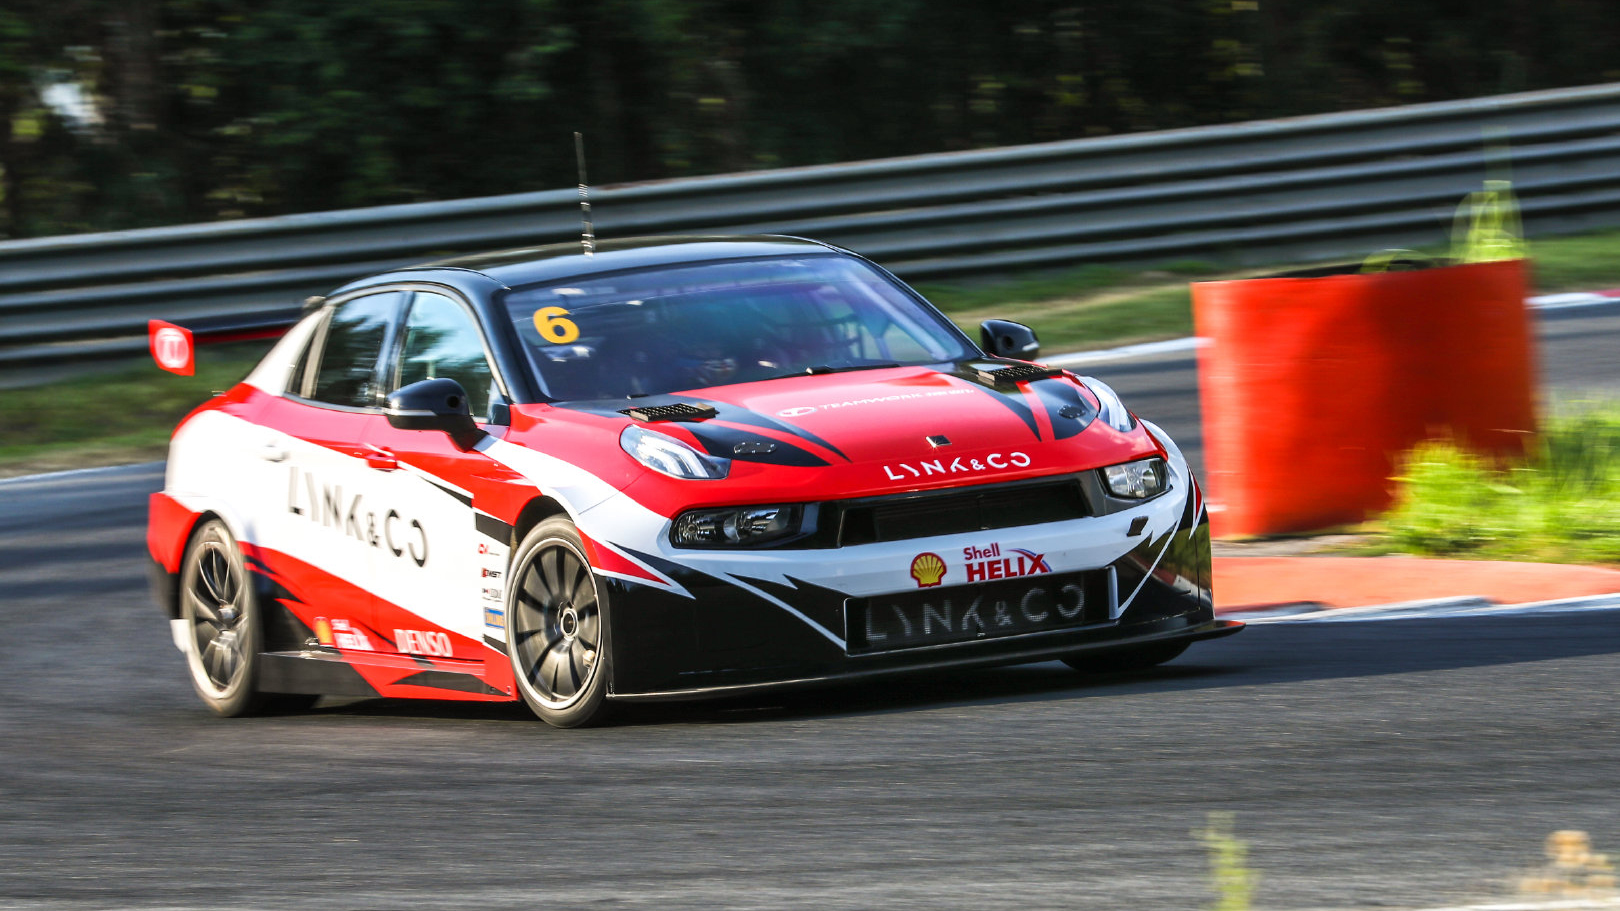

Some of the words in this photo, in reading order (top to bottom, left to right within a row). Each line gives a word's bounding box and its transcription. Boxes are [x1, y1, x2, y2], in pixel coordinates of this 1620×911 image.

[533, 306, 579, 344] 6
[963, 543, 1000, 561] Shell
[965, 554, 1050, 583] HELIX
[393, 629, 453, 657] DENSO
